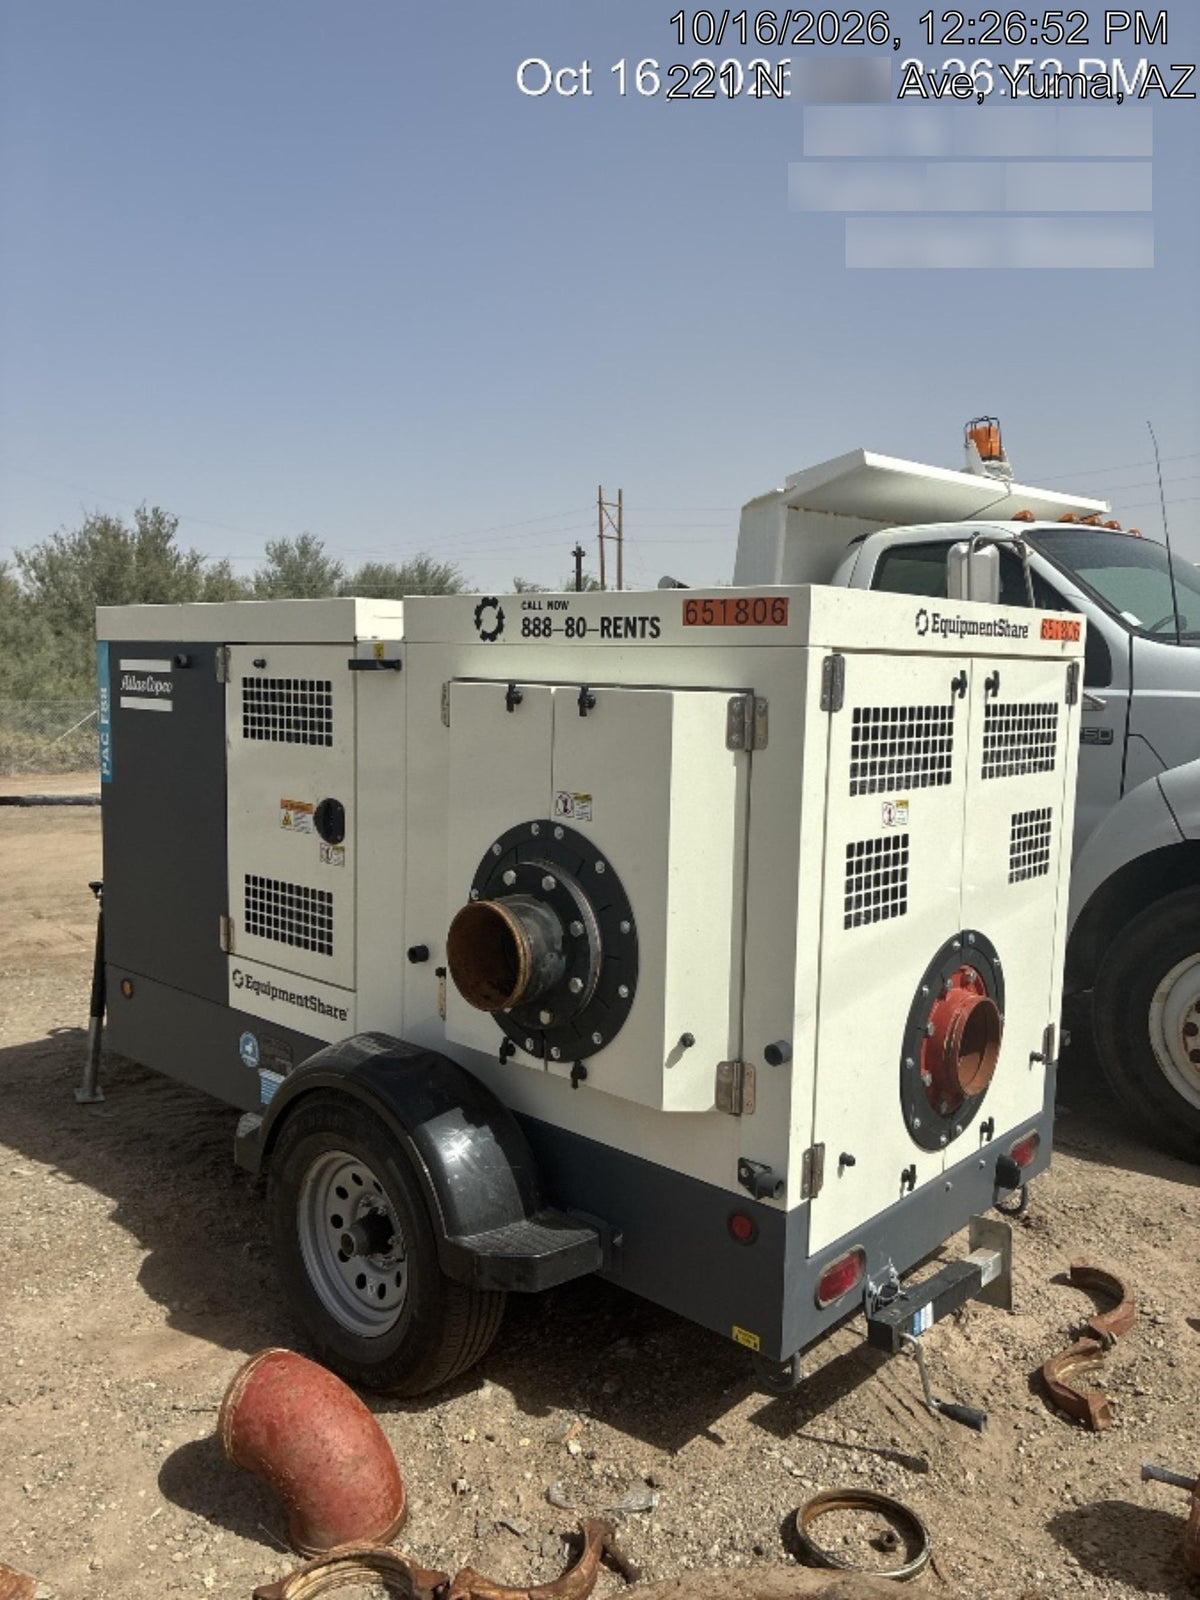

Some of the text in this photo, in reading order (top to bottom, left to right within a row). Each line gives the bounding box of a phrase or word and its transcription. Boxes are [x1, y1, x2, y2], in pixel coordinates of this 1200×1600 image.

[521, 600, 570, 611] CALL NOW
[684, 597, 786, 625] 651806
[521, 616, 661, 639] 888-80-RENTS
[931, 612, 1029, 638] EquipmentShare
[120, 674, 174, 696] Atlas Copco
[1080, 727, 1112, 744] 50
[100, 731, 110, 776] PAC
[244, 973, 348, 1021] EquipmentShare
